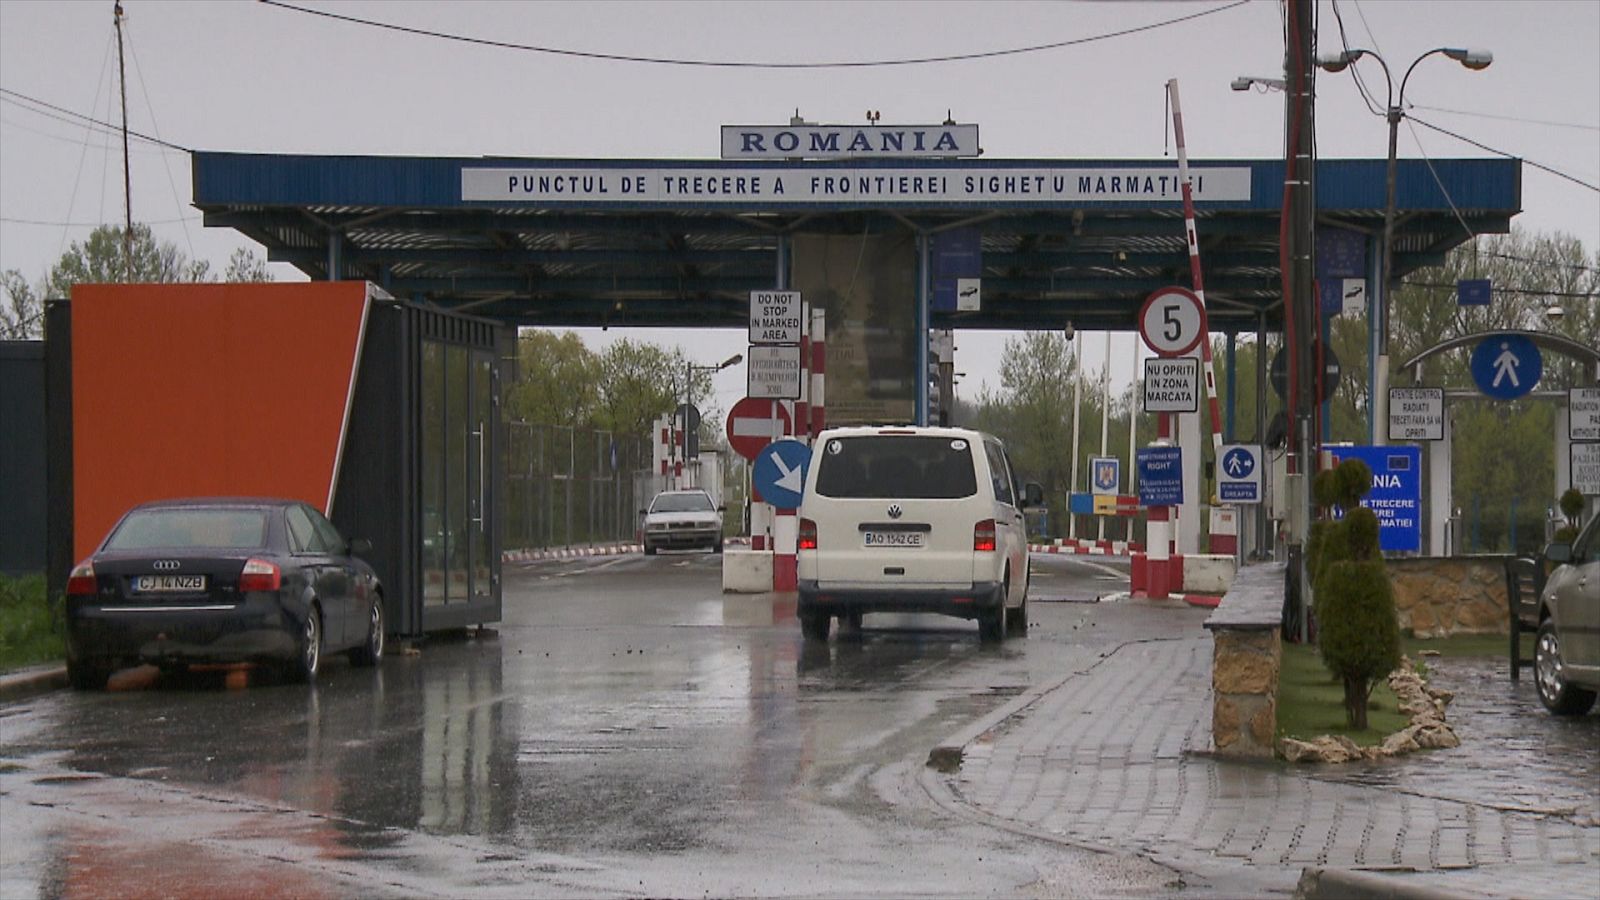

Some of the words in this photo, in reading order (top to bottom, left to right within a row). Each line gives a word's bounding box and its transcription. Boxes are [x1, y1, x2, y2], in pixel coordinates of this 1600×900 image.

[509, 176, 609, 193] PUNCTUL
[622, 176, 646, 193] DE
[664, 176, 761, 193] TRECERE
[774, 176, 785, 193] A
[758, 294, 772, 305] DO
[774, 294, 793, 305] NOT
[763, 306, 788, 317] STOP
[752, 318, 760, 328] IN
[762, 318, 799, 328] MARKED
[1164, 305, 1181, 342] 5
[762, 330, 788, 340] AREA
[1147, 365, 1160, 375] NU
[1162, 365, 1195, 375] OPRITI
[1151, 379, 1160, 388] IN
[1162, 378, 1189, 388] ZONA
[1147, 391, 1192, 402] MARCATA
[1415, 389, 1441, 400] CONTROL
[1147, 462, 1171, 470] RIGHT
[1371, 474, 1401, 489] NIA
[1371, 499, 1415, 509] TRECERE
[1379, 519, 1413, 529] MATIEI
[907, 533, 920, 545] CE
[140, 576, 157, 589] CJ
[161, 576, 173, 588] 14
[174, 575, 203, 589] NZB
